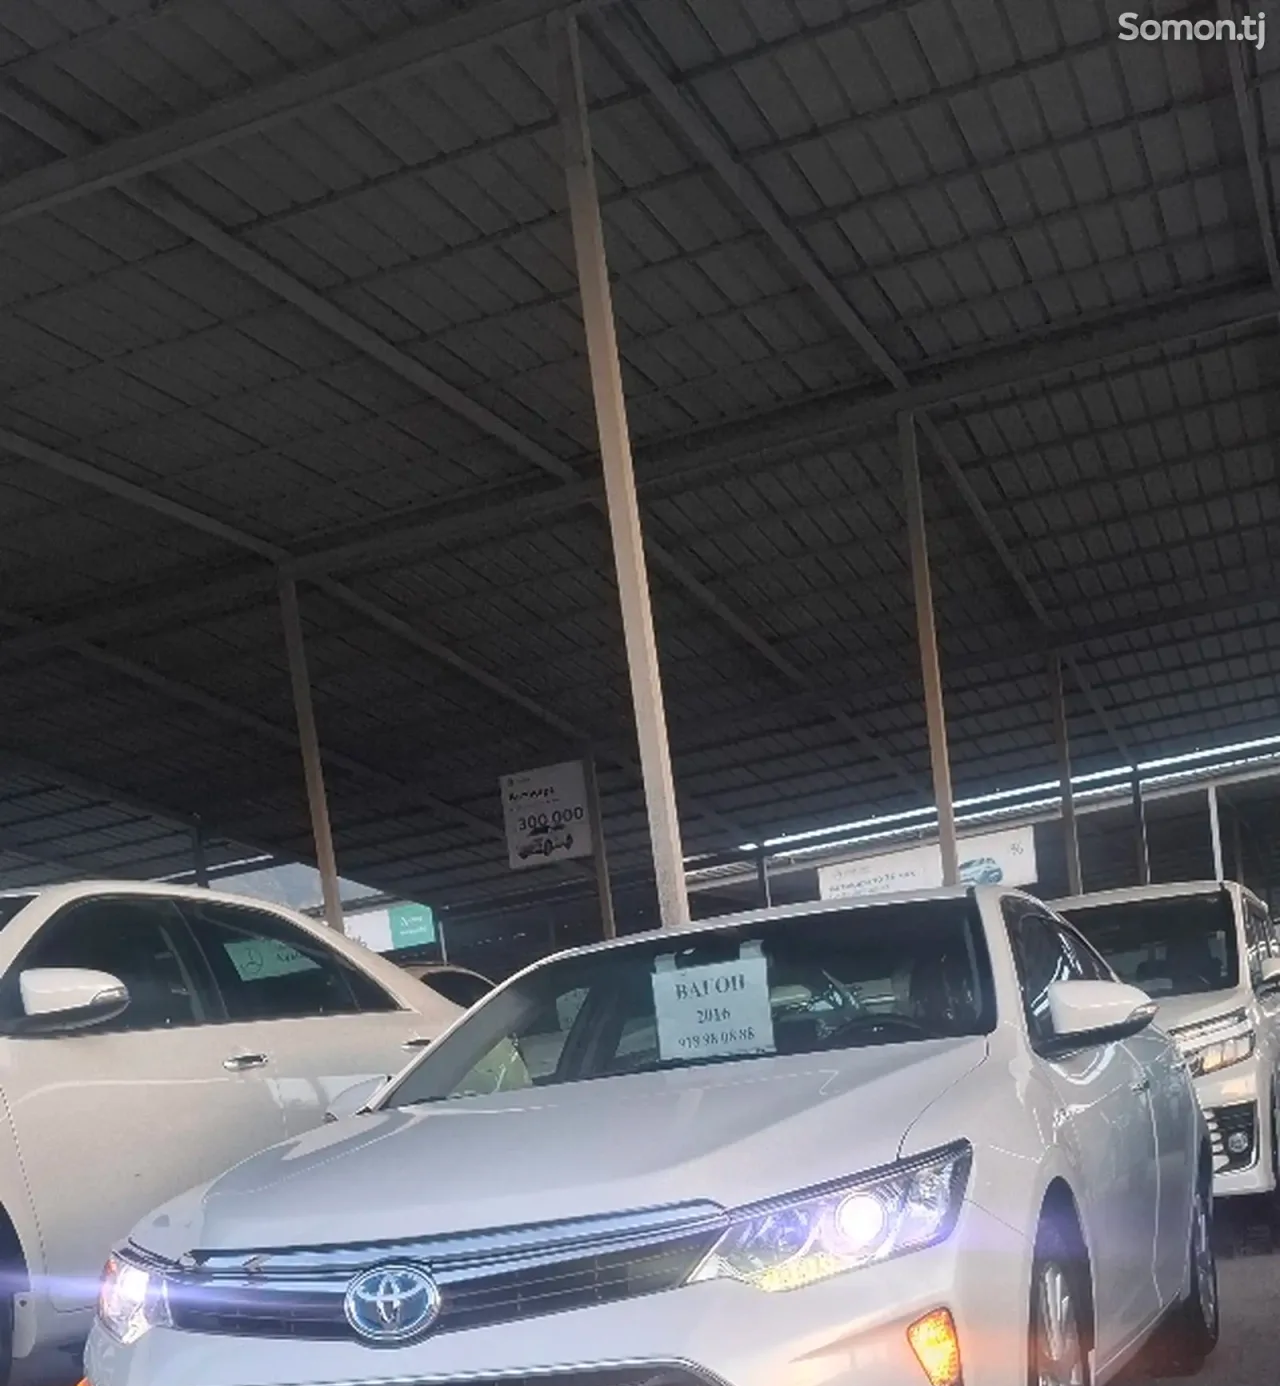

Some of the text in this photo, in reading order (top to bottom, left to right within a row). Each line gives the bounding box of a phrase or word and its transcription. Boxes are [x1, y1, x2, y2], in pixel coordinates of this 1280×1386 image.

[519, 806, 583, 831] 300 000
[696, 1007, 731, 1024] 2016
